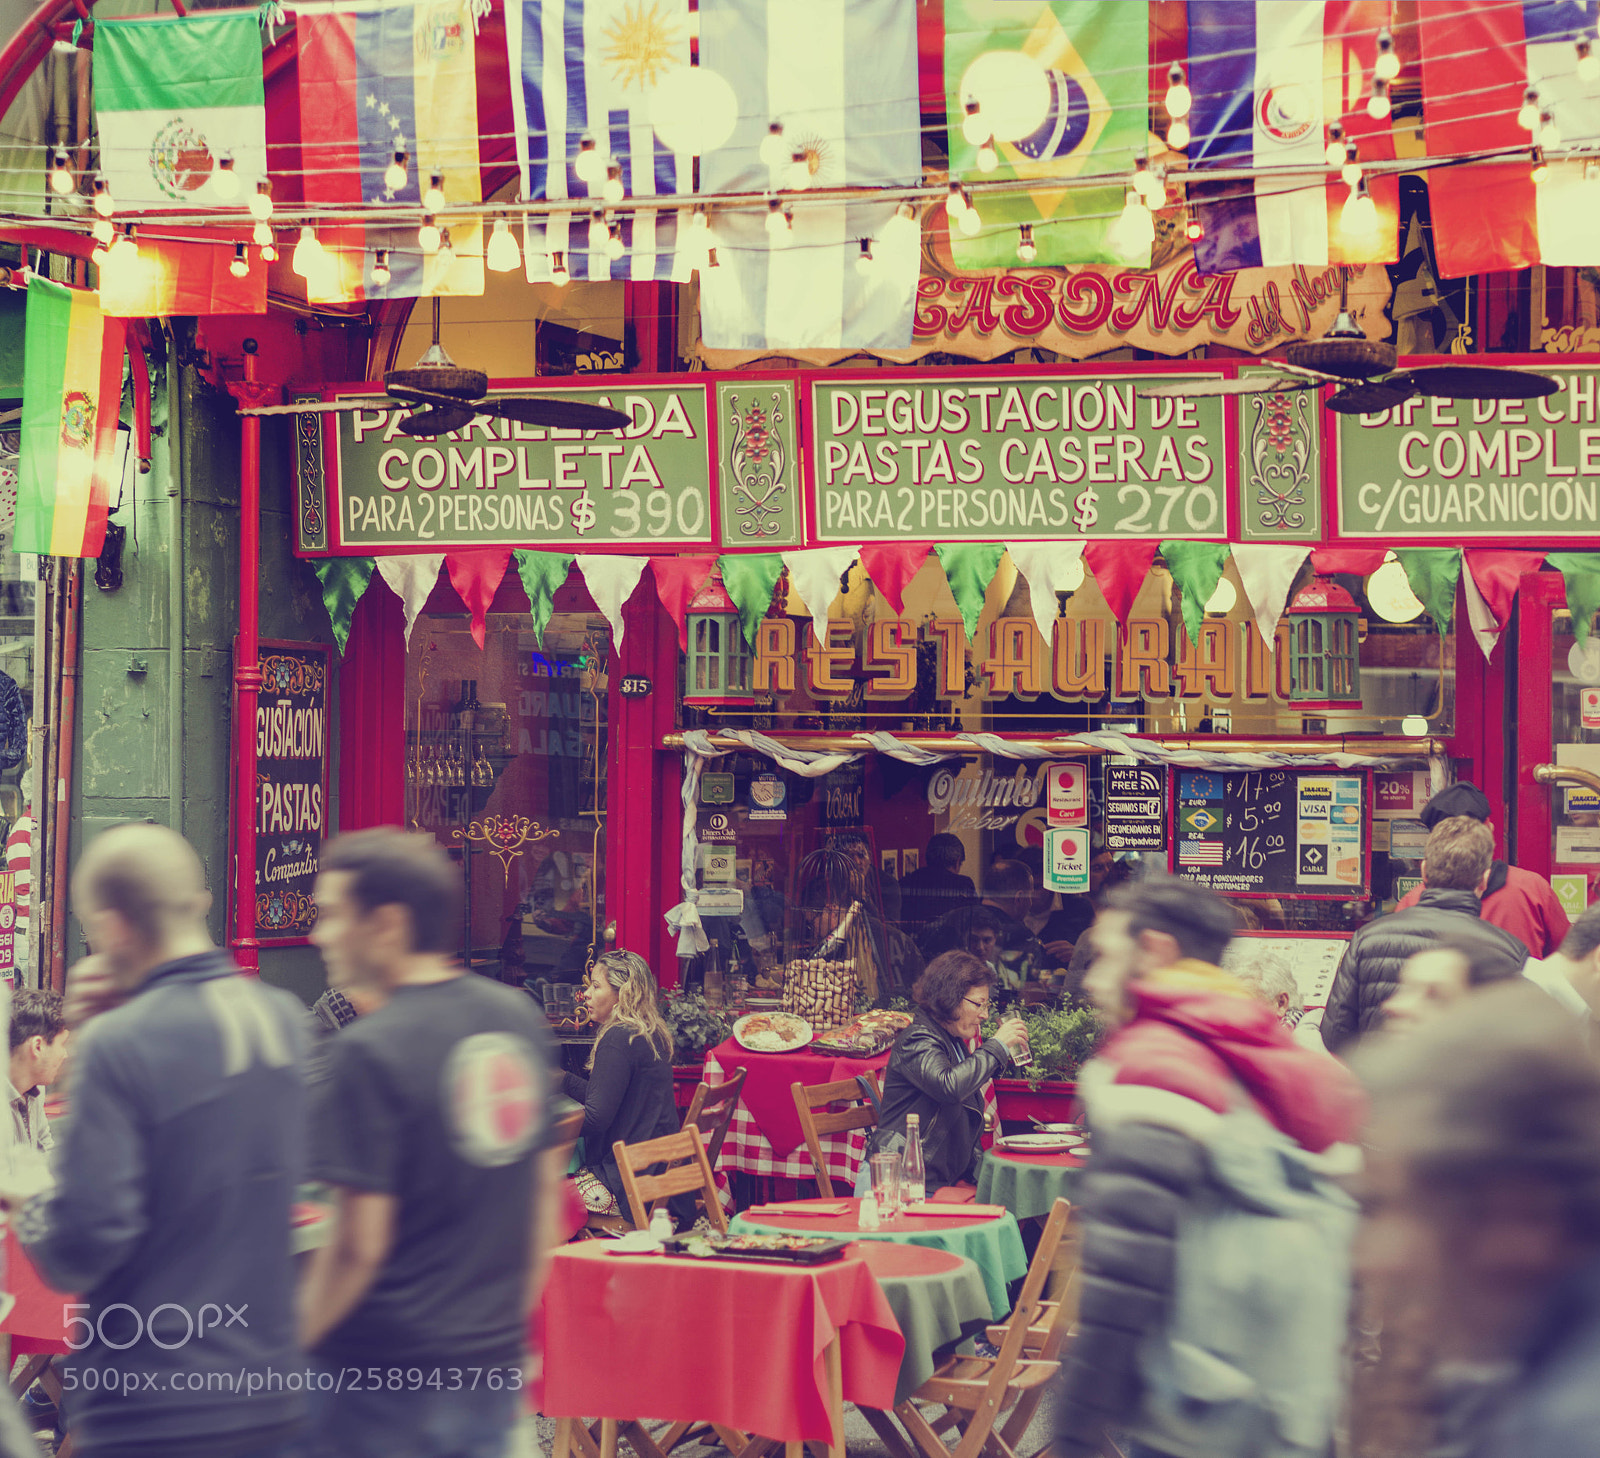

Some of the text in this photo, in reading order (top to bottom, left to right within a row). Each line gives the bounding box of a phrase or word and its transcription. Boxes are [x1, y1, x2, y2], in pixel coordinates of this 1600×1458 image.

[1538, 375, 1600, 424] CH
[830, 380, 1200, 437] DEGUSTACIÓN DE
[824, 433, 1215, 486] PASTAS CASERAS
[377, 444, 662, 491] COMPLETA
[348, 485, 705, 539] PARA 2 PERSONAS $ 390
[825, 484, 1219, 534] PARA 2 PERSONAS $ 270
[623, 679, 648, 693] 815
[927, 768, 1041, 815] Quilmes
[1111, 781, 1138, 790] FREE
[1379, 781, 1410, 795] 20%
[262, 783, 321, 834] PASTAS
[1059, 810, 1074, 818] Card
[1108, 802, 1138, 813] SEGUINOS
[1303, 804, 1326, 814] VISA
[721, 828, 736, 836] Club
[1125, 837, 1162, 847] tripadvisor
[265, 842, 318, 884] Compartir
[1056, 862, 1082, 871] Ticket
[1302, 865, 1325, 873] CABAL
